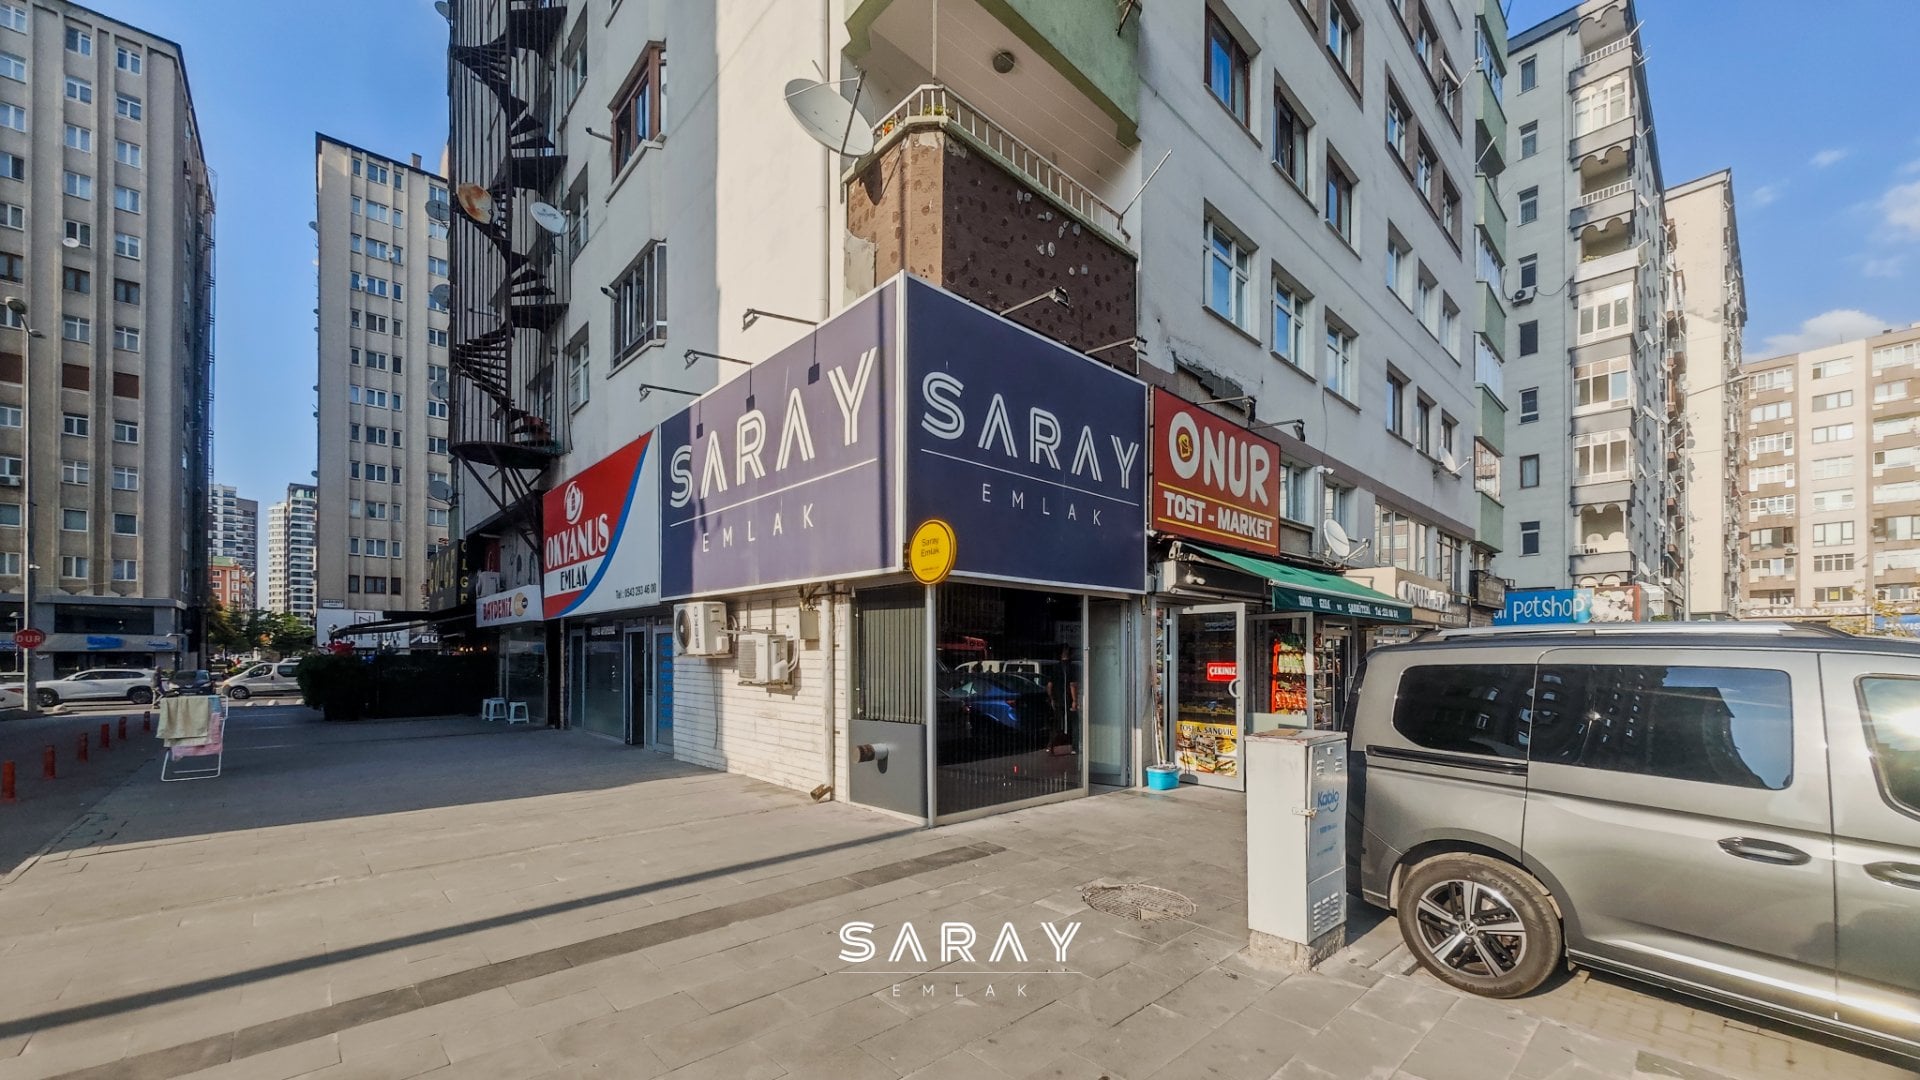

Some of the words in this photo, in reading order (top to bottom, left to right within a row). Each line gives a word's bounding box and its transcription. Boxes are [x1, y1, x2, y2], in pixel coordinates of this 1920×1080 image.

[670, 346, 877, 508] SARAY
[921, 371, 1139, 489] SARAY
[1168, 411, 1270, 507] ONUR
[982, 483, 1101, 526] EMLAK
[1163, 491, 1206, 525] TOST
[1217, 506, 1273, 541] MARKET
[546, 513, 609, 569] OKYANUS
[702, 503, 814, 552] EMLAK
[921, 537, 939, 547] Saray
[921, 547, 940, 558] Emlak
[560, 565, 588, 591] EMLAK
[1513, 594, 1585, 622] petshop
[1750, 608, 1806, 617] SALON
[16, 634, 42, 643] DUR
